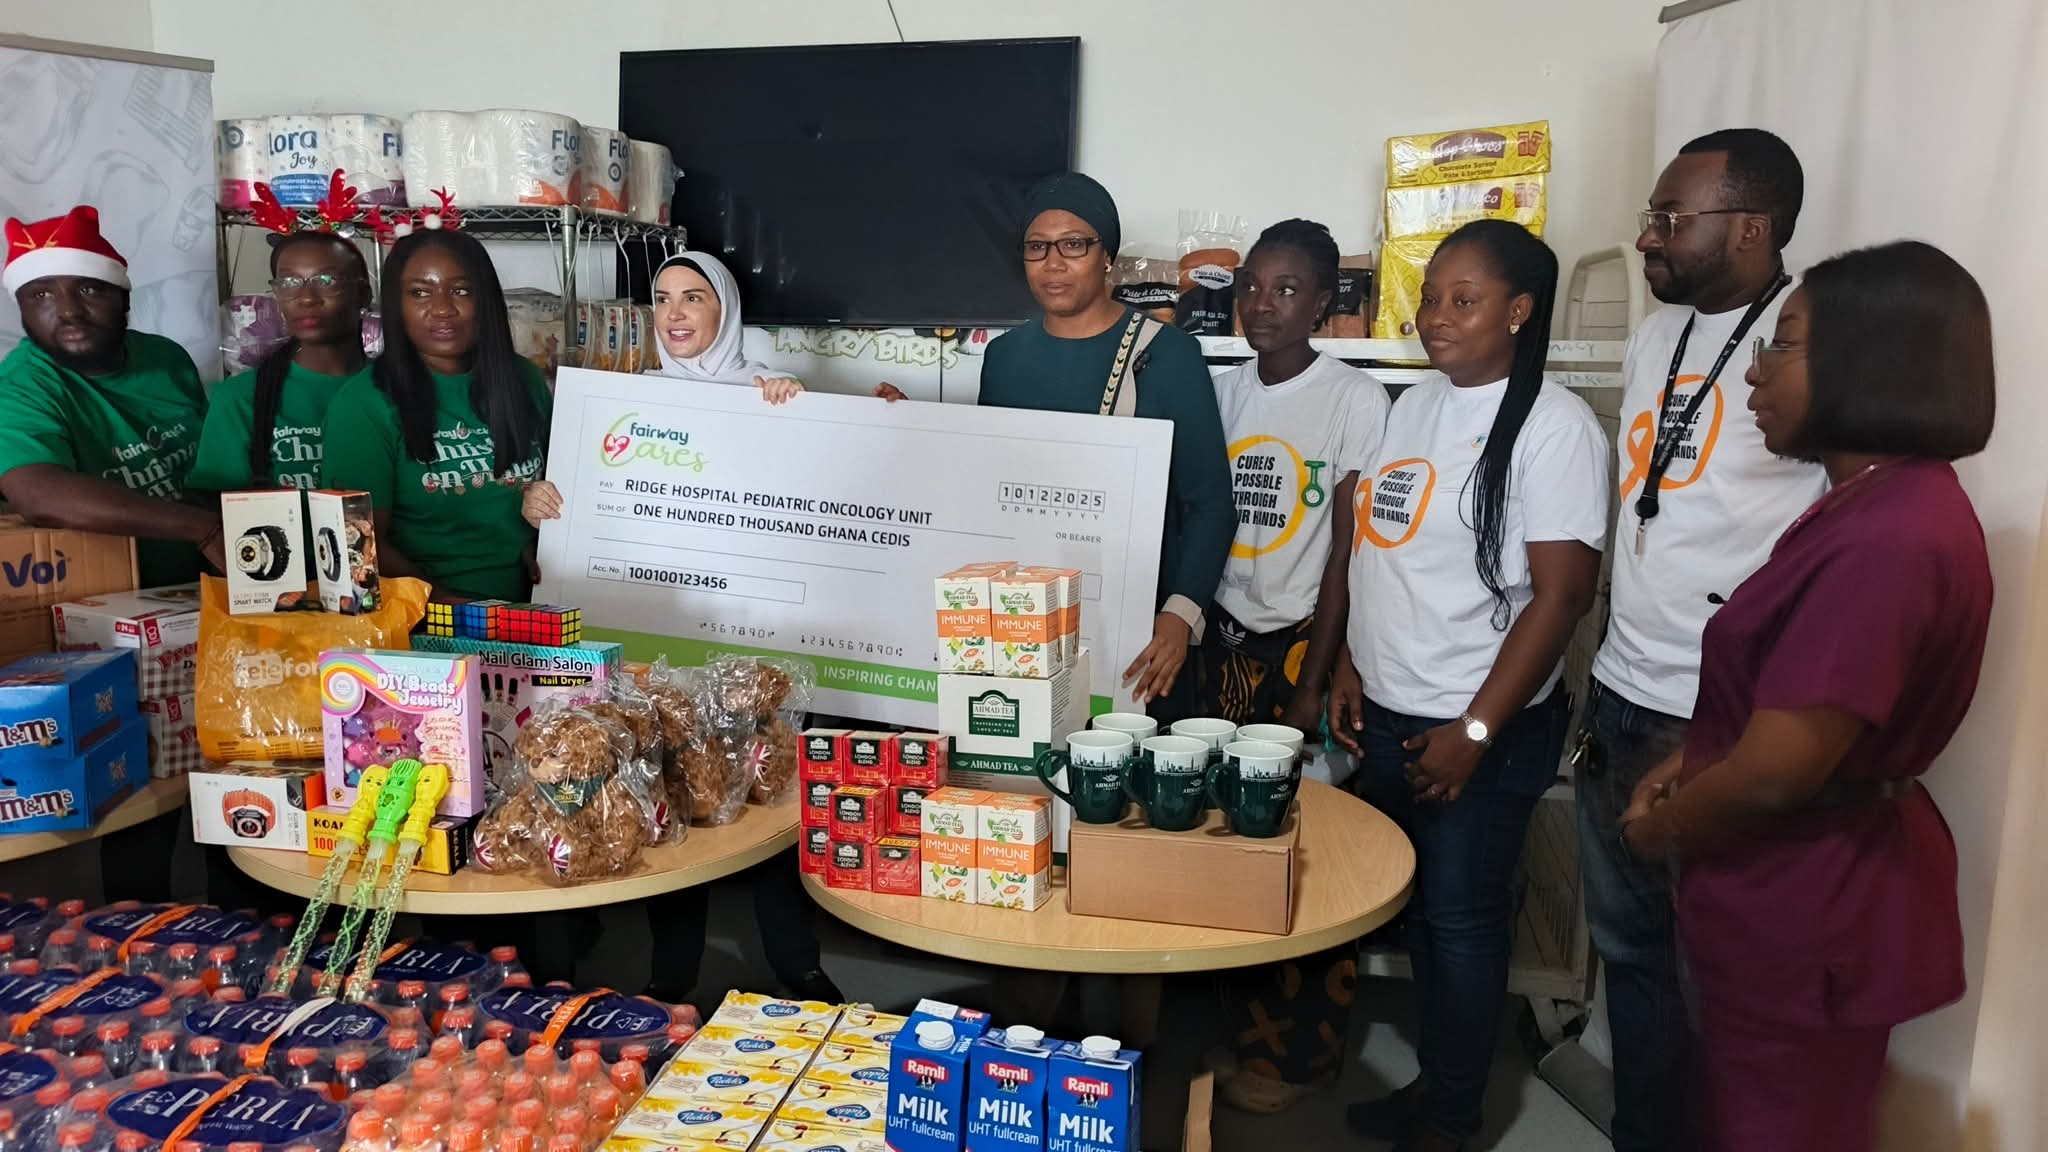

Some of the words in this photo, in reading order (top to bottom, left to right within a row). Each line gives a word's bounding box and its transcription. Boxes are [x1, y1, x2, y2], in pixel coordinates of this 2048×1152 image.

[269, 130, 318, 157] lora
[289, 151, 318, 169] Joy
[774, 326, 874, 358] ANGRY
[873, 332, 960, 370] BIRDS
[272, 424, 321, 440] fairway
[630, 422, 689, 446] fairway
[1672, 444, 1698, 460] ANDS
[1237, 455, 1264, 470] CURE
[1263, 456, 1275, 471] IS
[1387, 470, 1409, 481] CURE
[1404, 472, 1417, 482] IS
[1378, 479, 1415, 495] POSSIBLE
[599, 480, 615, 489] PAY
[625, 479, 669, 496] RIDGE
[671, 484, 739, 504] HOSPITAL
[743, 491, 816, 513] PEDIATRIC
[818, 500, 896, 521] ONCOLOGY
[898, 508, 933, 526] UNIT
[1373, 492, 1407, 509] THROUGH
[596, 503, 614, 512] SUM
[633, 502, 663, 518] ONE
[666, 507, 736, 527] HUNDRED
[739, 514, 815, 537] THOUSAND
[818, 525, 868, 543] GHANA
[871, 530, 911, 547] CEDIS
[1372, 506, 1386, 520] OUR
[1386, 508, 1410, 525] HANDS
[1055, 531, 1067, 540] OR
[1069, 532, 1102, 544] BEARER
[609, 565, 621, 574] No.
[628, 566, 728, 590] 100100123456
[941, 614, 987, 625] IMMUNE
[996, 619, 1043, 631] IMMUNE
[479, 650, 507, 666] Nail
[510, 653, 548, 669] Glam
[552, 655, 593, 673] Salon
[376, 673, 405, 691] DIY
[407, 675, 458, 695] Beads
[539, 676, 558, 686] Nail
[560, 676, 587, 687] Dryer
[822, 664, 894, 688] INSPIRING
[897, 674, 937, 693] CHAN
[398, 689, 463, 715] Jewelry
[975, 705, 1000, 713] AHMAD
[1001, 707, 1014, 715] TEA
[970, 759, 1002, 771] AHMAD
[1003, 761, 1019, 772] TEA
[925, 838, 971, 855] IMMUNE
[983, 844, 1031, 861] IMMUNE
[907, 1059, 945, 1081] Ramli
[988, 1063, 1029, 1082] Ramli
[1067, 1077, 1109, 1097] Ramli
[898, 1093, 950, 1126] Milk
[979, 1097, 1033, 1129] Milk
[888, 1115, 909, 1130] UHT
[911, 1119, 955, 1143] fullcream
[968, 1121, 990, 1134] UHT
[993, 1122, 1040, 1146] fullcream
[1059, 1112, 1115, 1144] Milk
[1049, 1138, 1072, 1152] UHT
